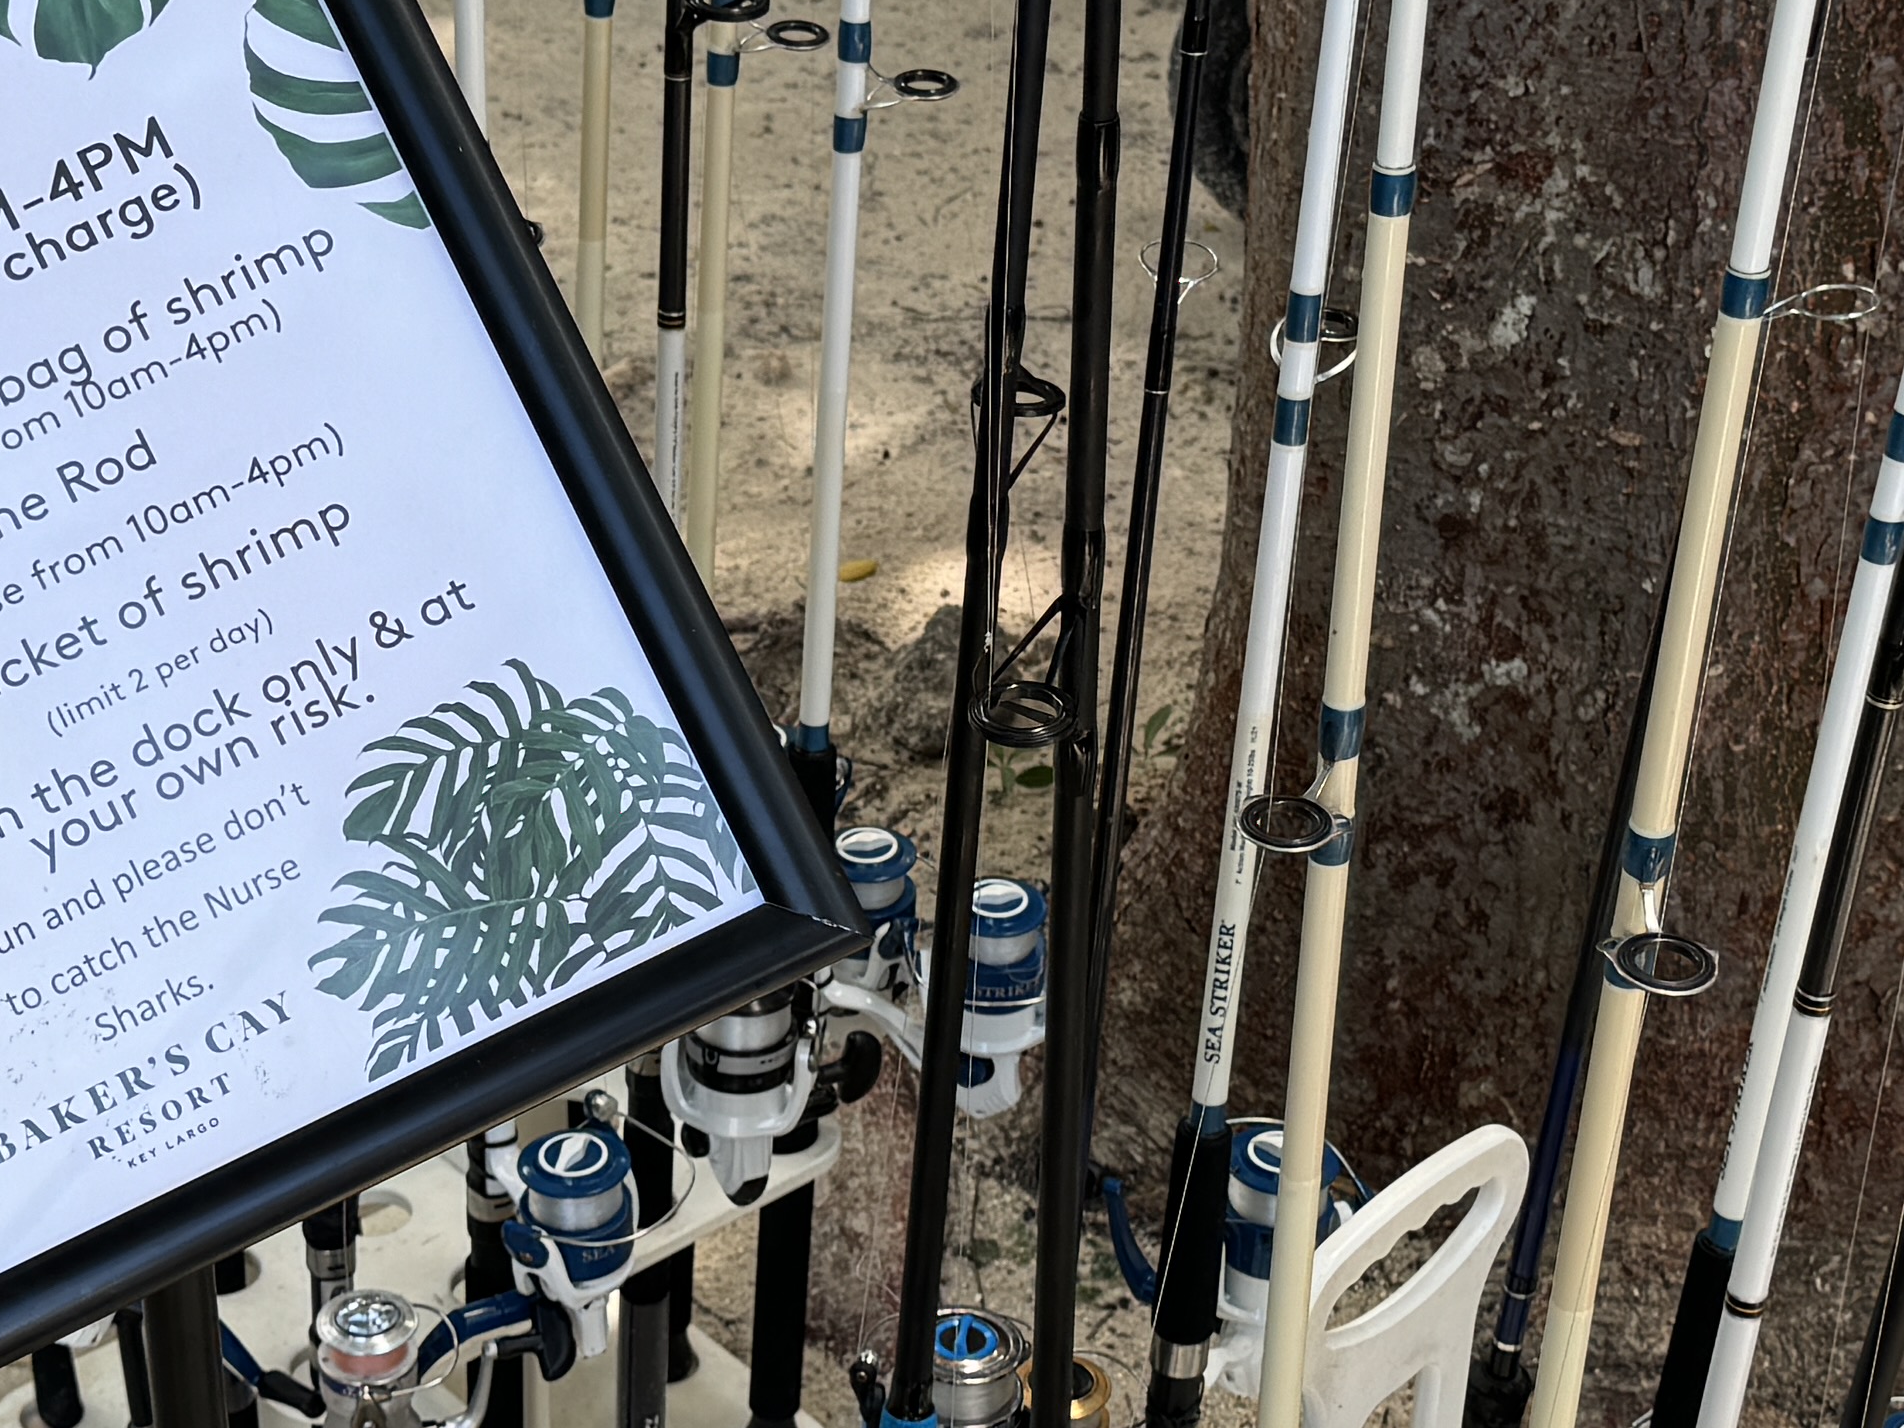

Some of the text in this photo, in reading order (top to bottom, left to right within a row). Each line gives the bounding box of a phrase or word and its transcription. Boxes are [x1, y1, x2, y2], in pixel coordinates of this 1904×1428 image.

[4, 163, 200, 280] charge)
[103, 300, 151, 354] of
[167, 230, 333, 325] shrimp
[64, 299, 281, 417] 10am-4pm)
[31, 536, 123, 590] from
[126, 423, 343, 542] 10am-4pm)
[56, 428, 157, 503] Rod
[119, 575, 167, 629] of
[181, 504, 349, 600] shrimp
[31, 752, 119, 816] the
[133, 689, 252, 767] dock
[262, 636, 357, 703] only
[369, 611, 414, 648] &
[421, 580, 475, 626] at
[48, 609, 272, 737] (limit 2 per day)
[29, 686, 376, 874] your own risk.
[5, 987, 41, 1015] to
[51, 937, 137, 994] catch
[142, 909, 200, 949] the
[204, 860, 300, 918] Nurse
[43, 879, 105, 929] and
[112, 833, 216, 903] please
[95, 976, 213, 1041] Sharks.
[205, 991, 290, 1053] CAY
[1204, 923, 1236, 1064] SEA STRIKER
[87, 1073, 230, 1160] RESORT
[128, 1118, 219, 1168] KEY LARGO
